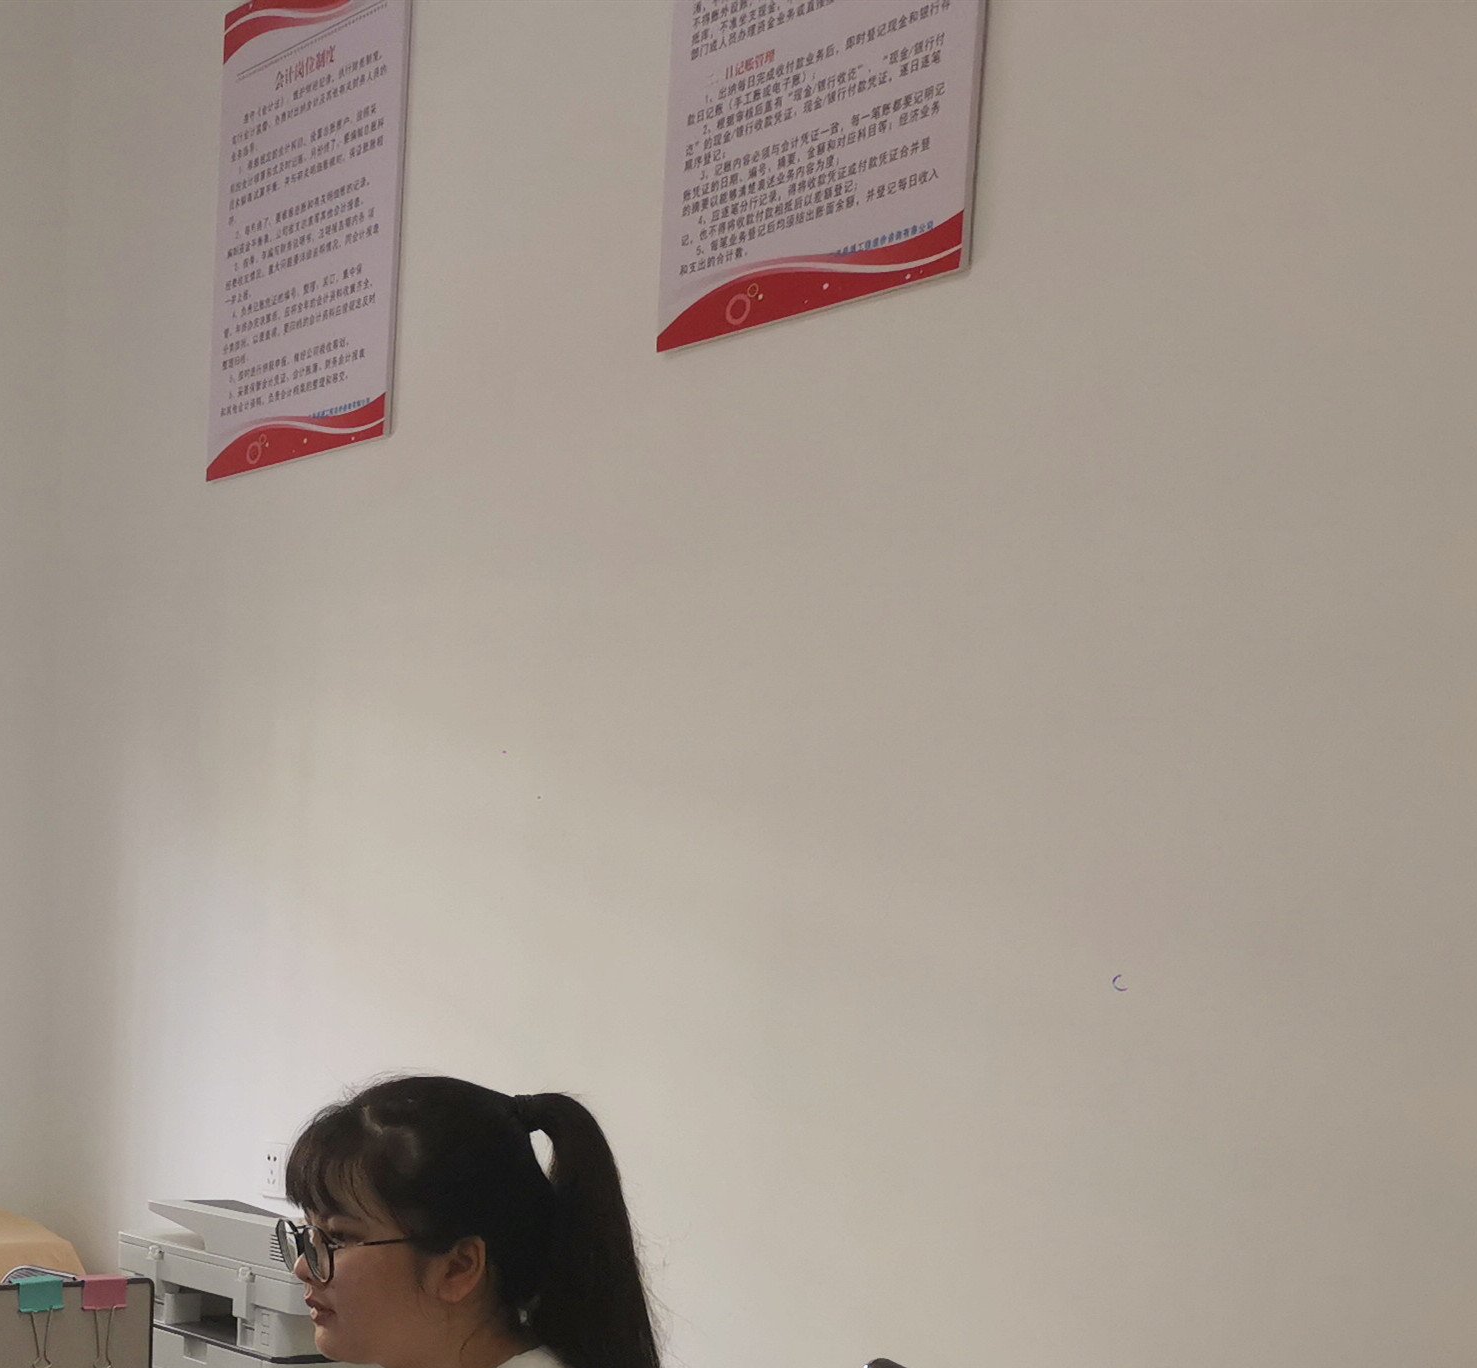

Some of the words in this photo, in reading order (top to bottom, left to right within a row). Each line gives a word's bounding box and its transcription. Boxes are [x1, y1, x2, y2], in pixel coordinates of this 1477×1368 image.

[275, 44, 335, 91] 会计岗位制度
